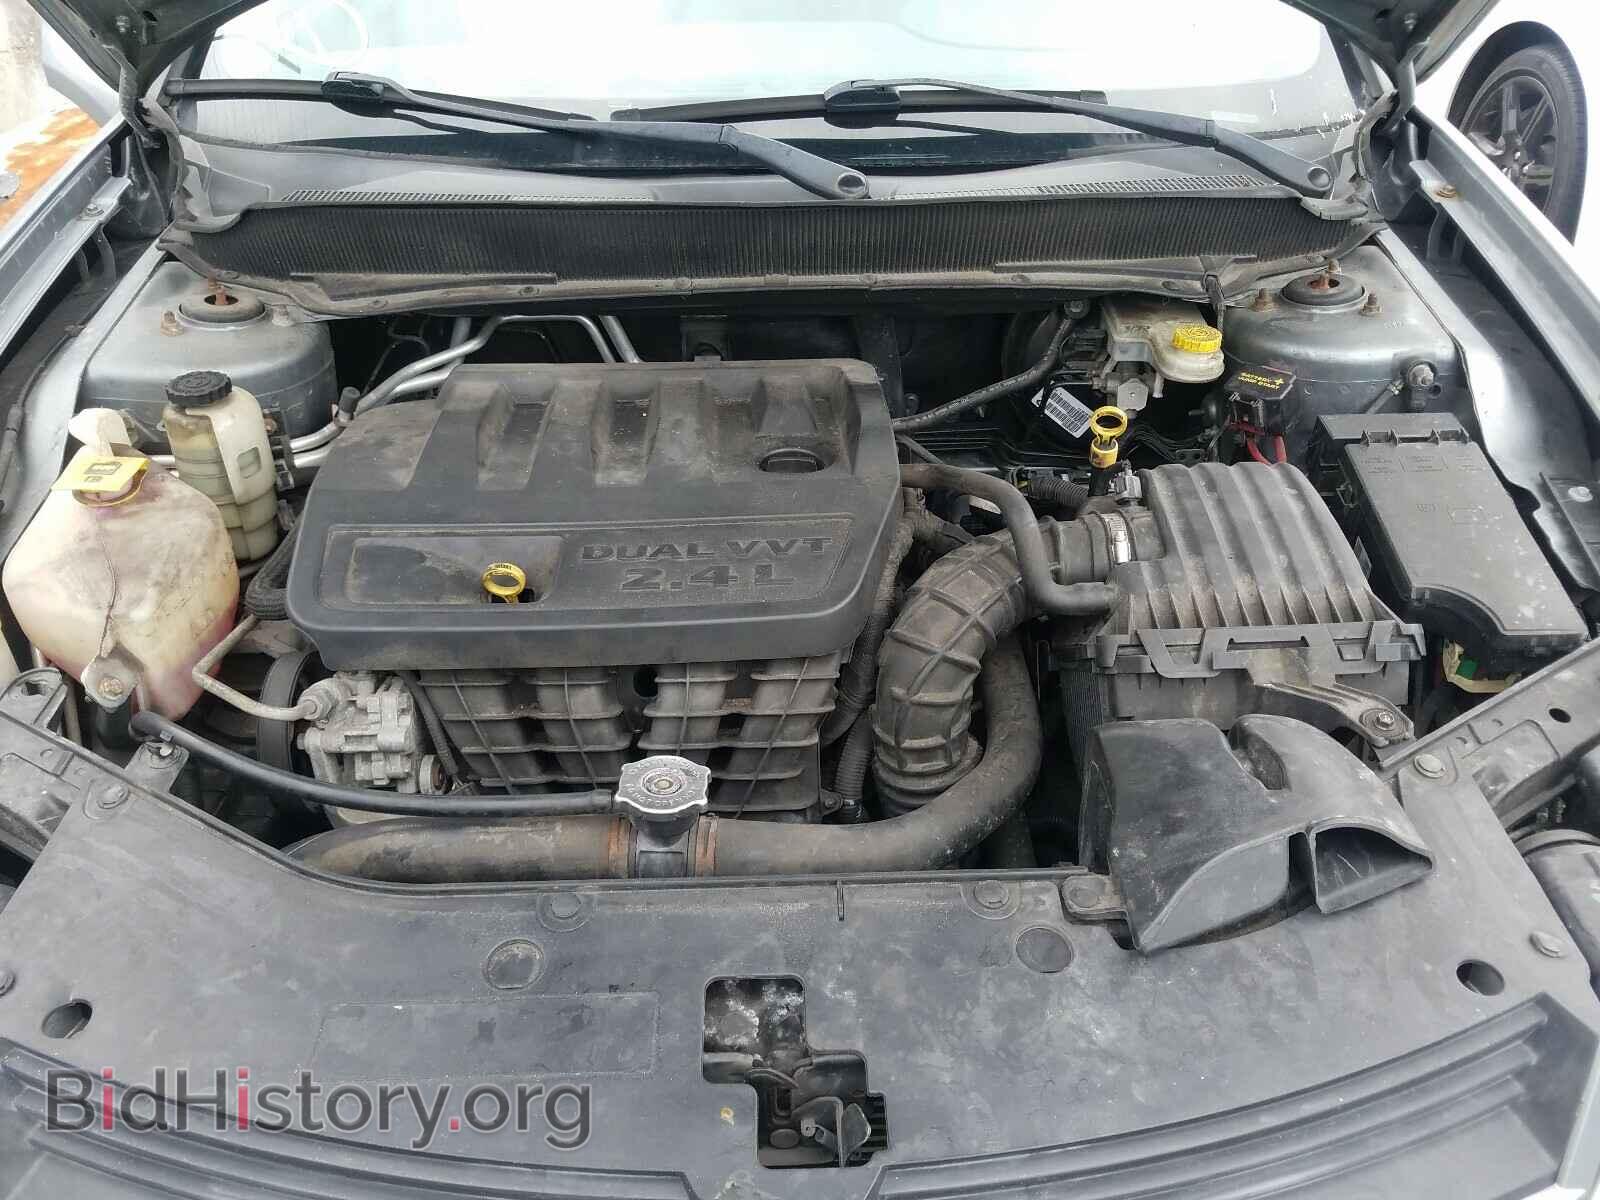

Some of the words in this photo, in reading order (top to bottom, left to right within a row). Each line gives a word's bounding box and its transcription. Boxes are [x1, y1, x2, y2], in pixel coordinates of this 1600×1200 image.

[581, 543, 716, 561] DUAL
[726, 536, 833, 556] VVT
[620, 564, 795, 591] 2.4L
